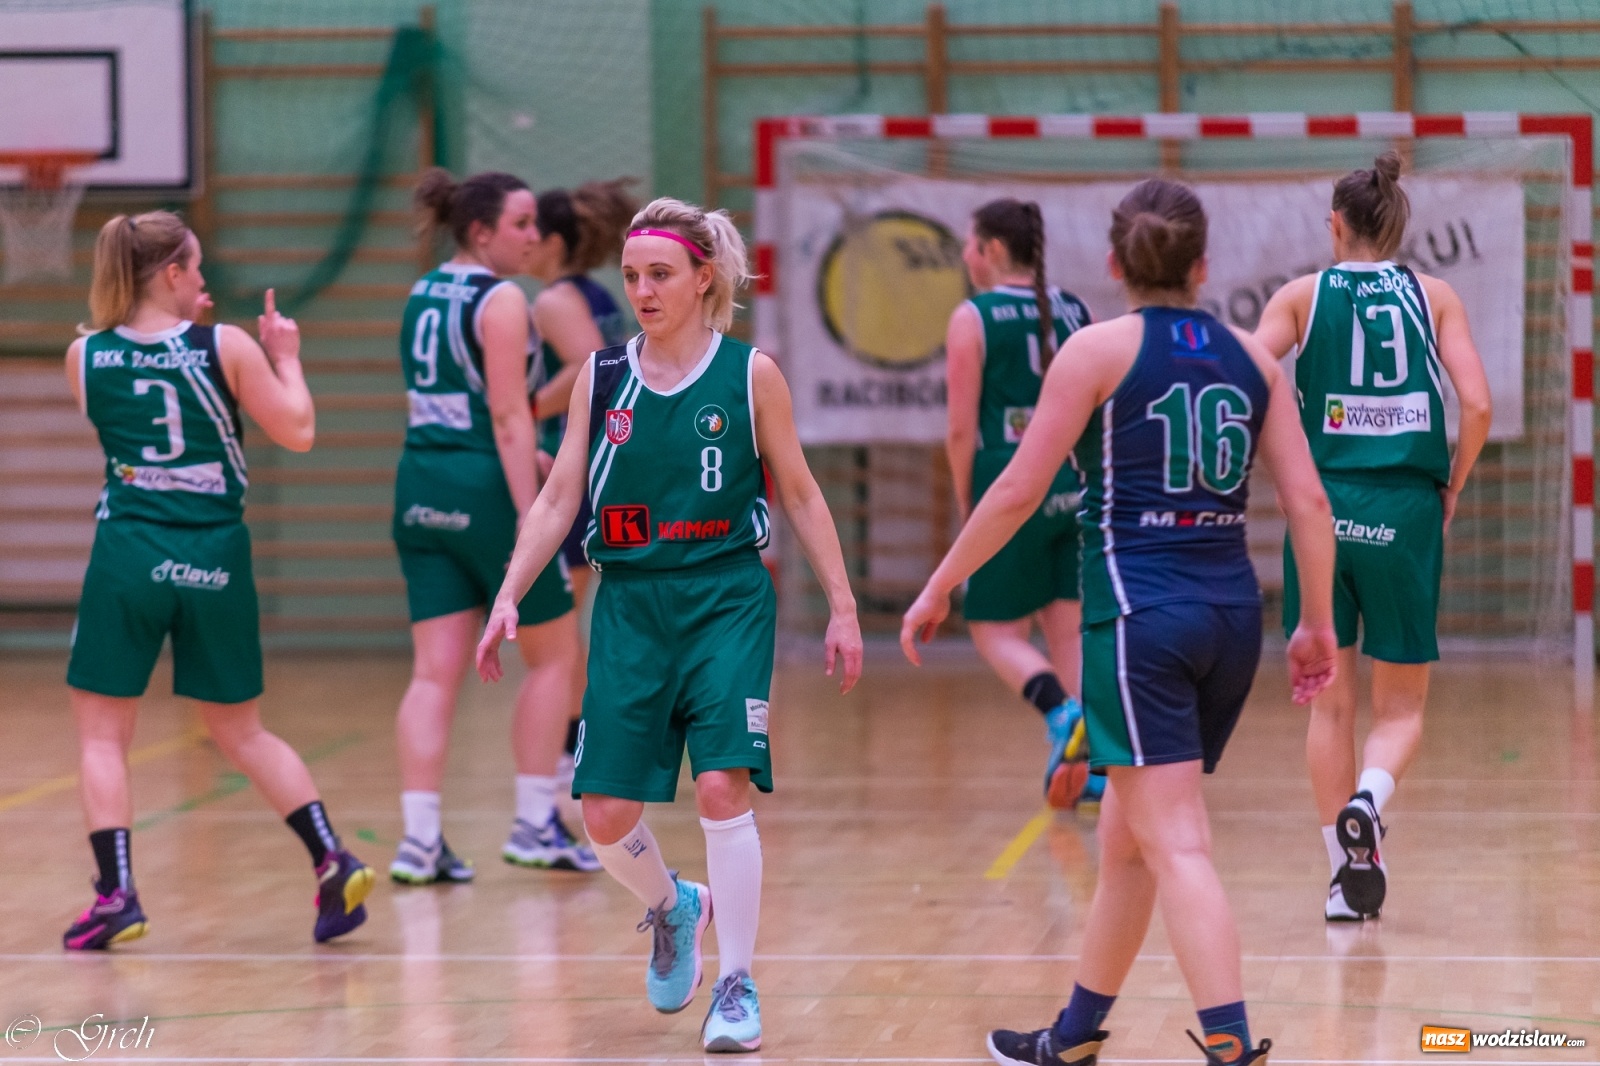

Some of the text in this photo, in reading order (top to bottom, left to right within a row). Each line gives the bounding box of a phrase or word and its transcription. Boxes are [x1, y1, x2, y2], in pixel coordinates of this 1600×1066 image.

[413, 308, 441, 387] 9
[1350, 303, 1409, 388] 13
[133, 379, 186, 462] 3
[1346, 408, 1428, 428] WAGTECH
[1146, 383, 1253, 495] 16
[701, 446, 722, 492] 8
[605, 510, 647, 542] K
[658, 519, 730, 540] KAMAN
[1335, 519, 1396, 542] Clavis
[171, 563, 230, 586] Clavis
